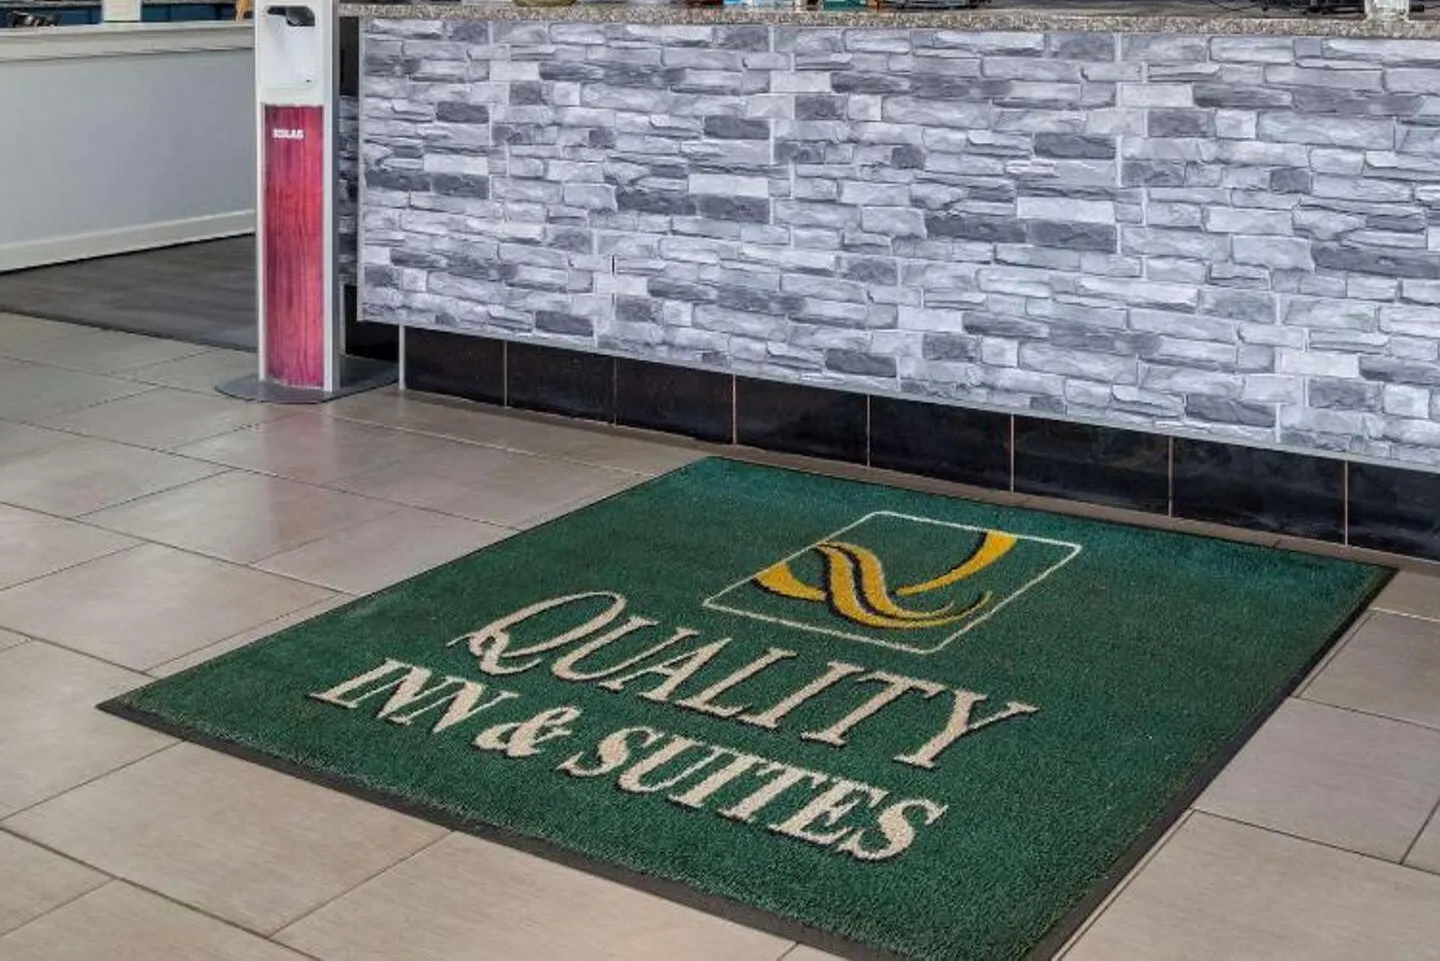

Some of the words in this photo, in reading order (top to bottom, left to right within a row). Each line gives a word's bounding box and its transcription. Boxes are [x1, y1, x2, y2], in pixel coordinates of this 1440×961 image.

[308, 656, 519, 733] INN
[472, 705, 582, 759] &
[559, 724, 950, 863] SUITES
[448, 589, 1041, 770] QUALITY
